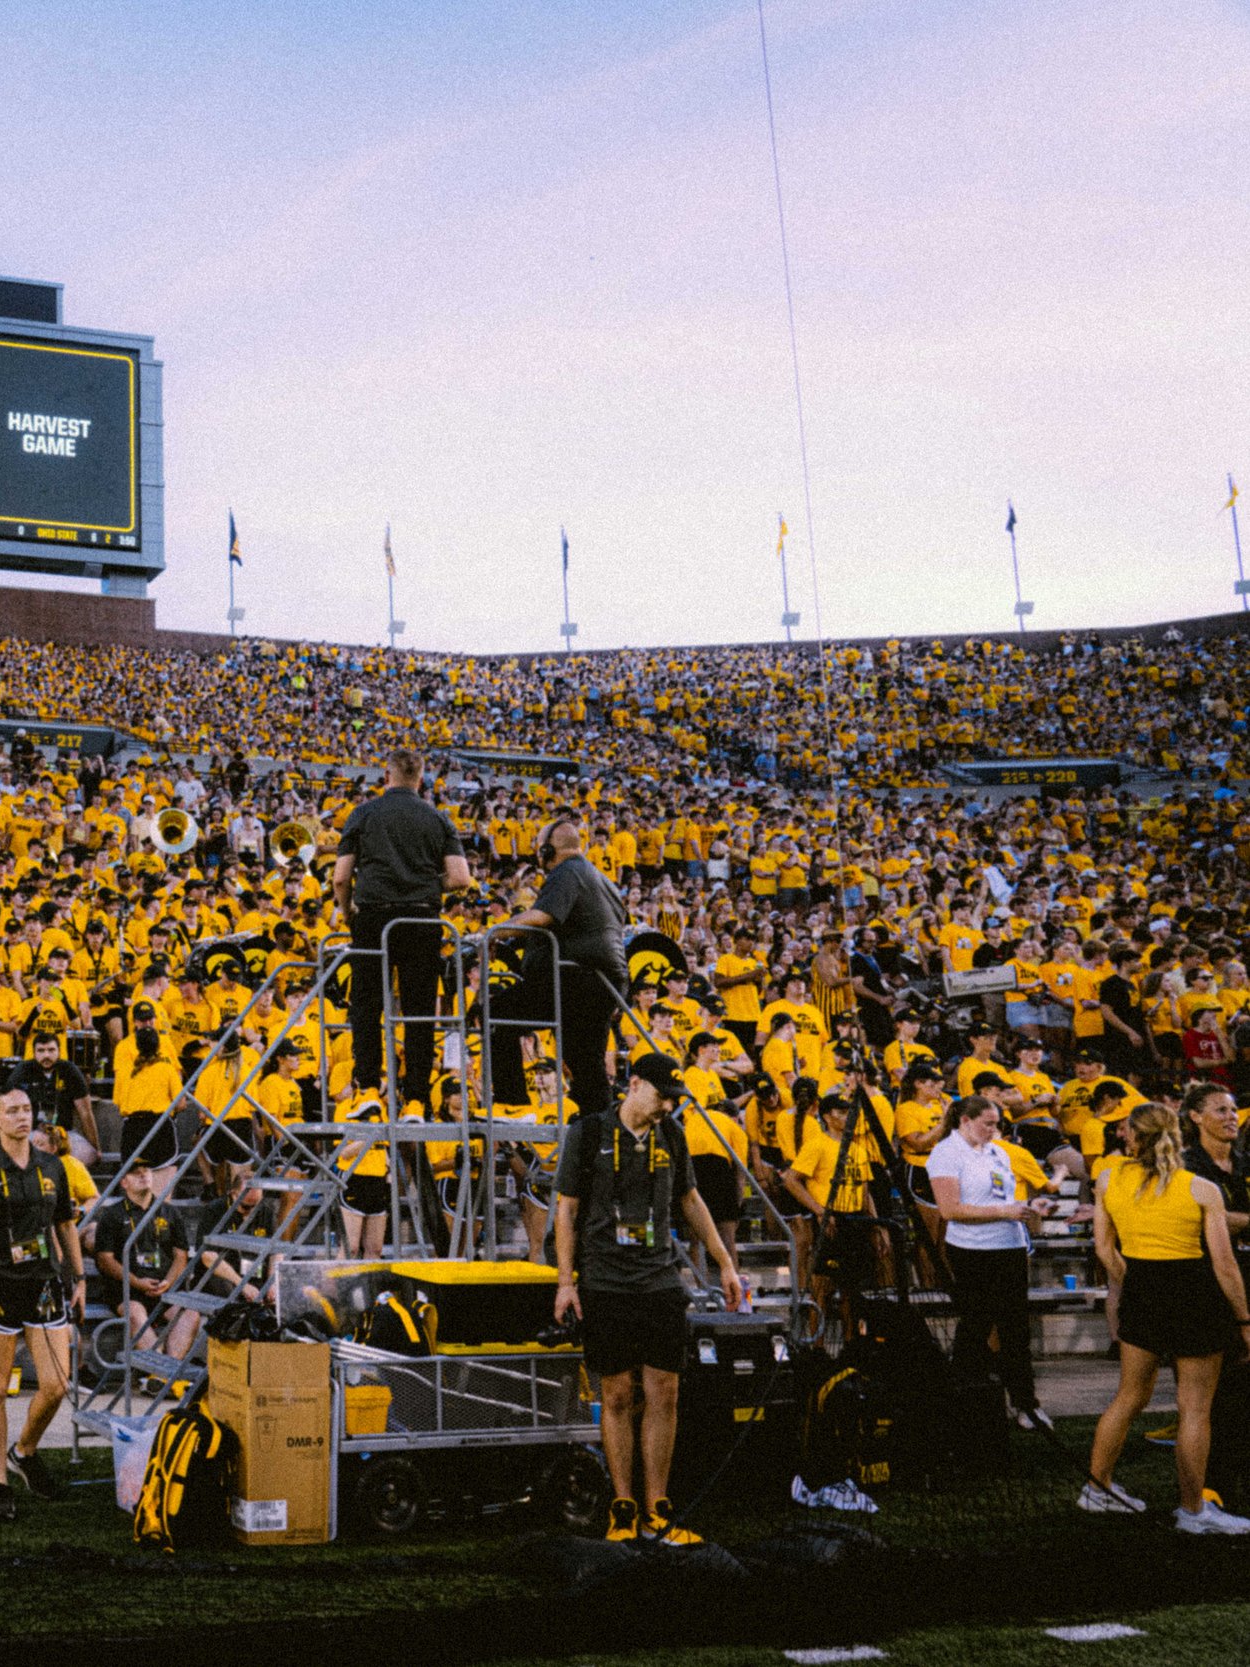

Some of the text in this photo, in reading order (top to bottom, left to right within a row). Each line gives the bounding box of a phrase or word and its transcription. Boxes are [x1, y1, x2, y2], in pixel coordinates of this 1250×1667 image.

[8, 411, 91, 438] HARVEST
[22, 433, 76, 457] GAME
[56, 733, 83, 747] 217
[1045, 770, 1077, 783] 220
[37, 1019, 62, 1029] IOWA
[176, 1016, 200, 1031] IOWA
[287, 1436, 324, 1448] DMR-9
